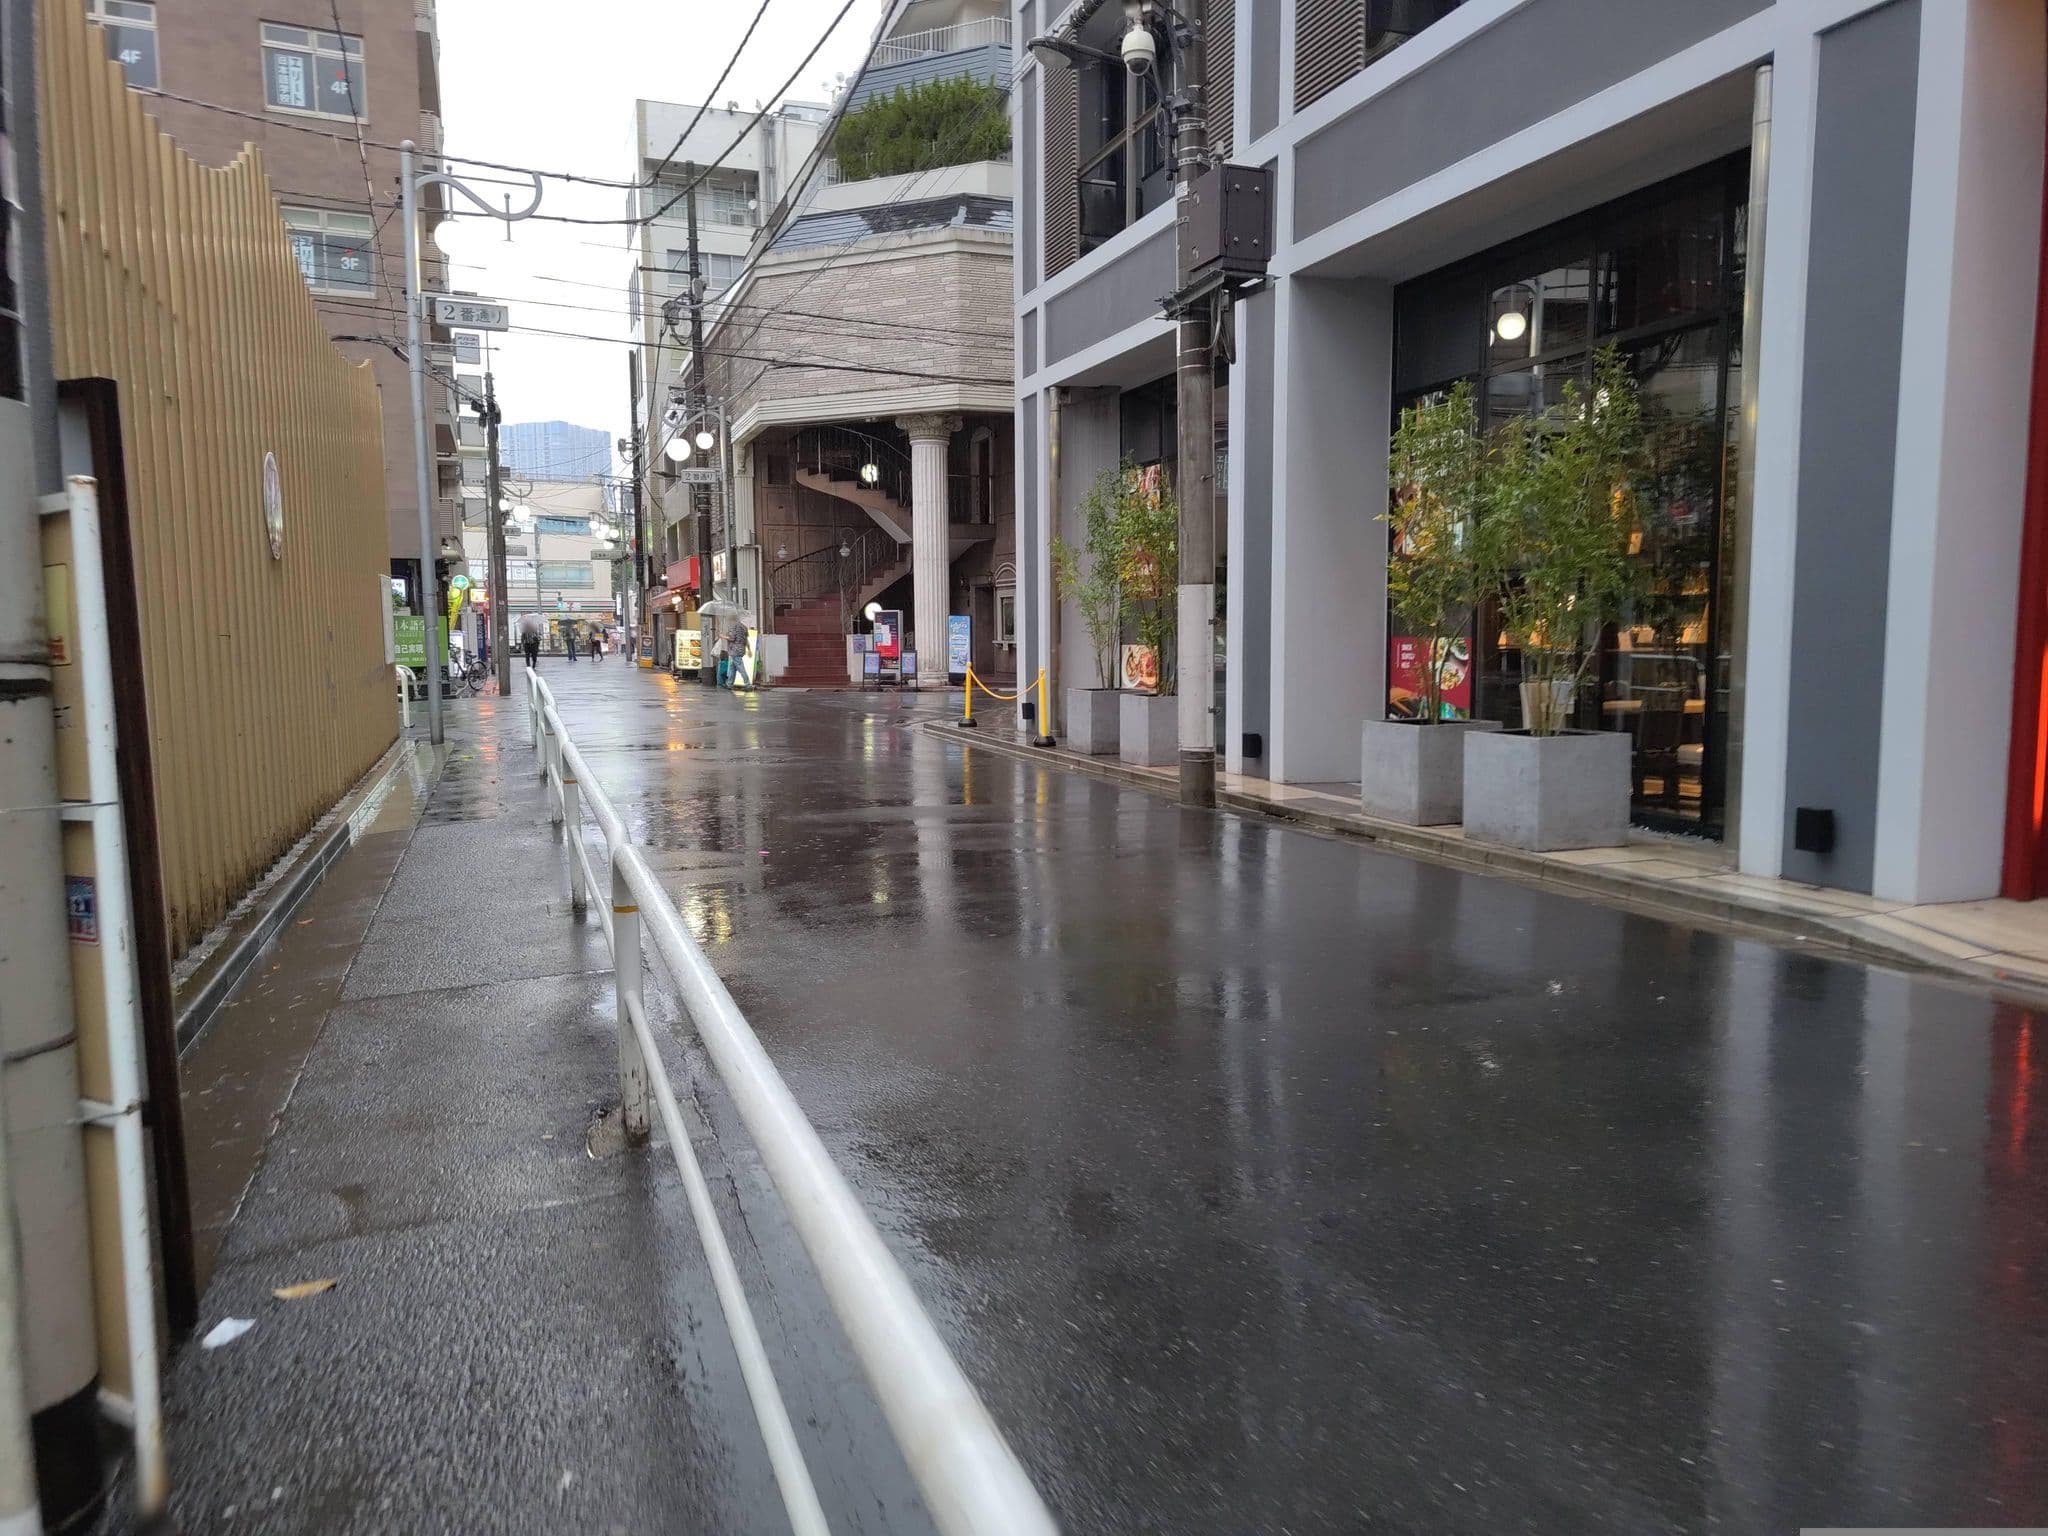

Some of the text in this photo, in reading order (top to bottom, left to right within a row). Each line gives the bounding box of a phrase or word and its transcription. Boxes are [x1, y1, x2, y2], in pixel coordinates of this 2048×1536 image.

[119, 49, 142, 64] 4F
[331, 81, 349, 95] 4F
[341, 256, 359, 270] 3F
[444, 304, 503, 324] 2番通り
[685, 472, 713, 481] 2番通り
